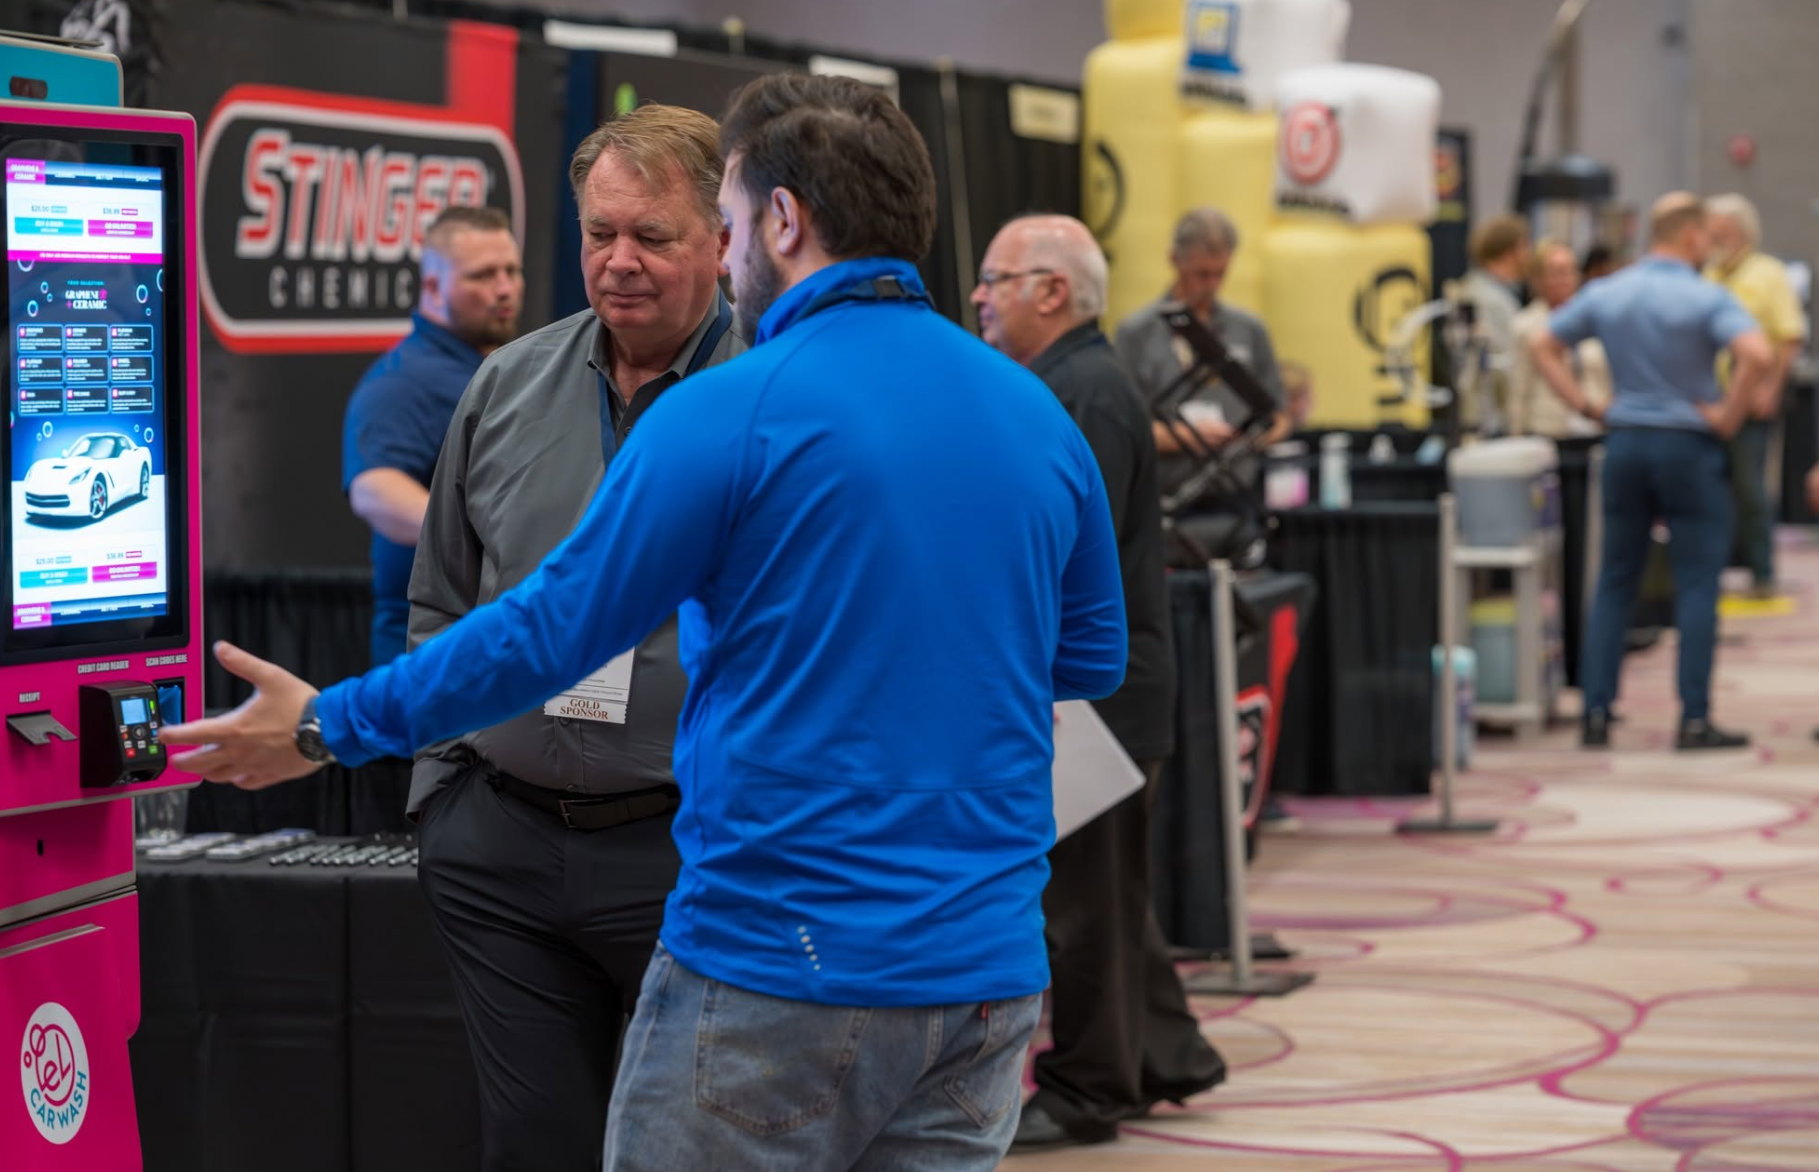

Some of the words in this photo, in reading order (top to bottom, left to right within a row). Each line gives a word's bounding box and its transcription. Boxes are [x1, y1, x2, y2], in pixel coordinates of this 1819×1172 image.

[268, 266, 414, 308] CHEMIC
[73, 300, 107, 310] CERAMIC
[78, 663, 95, 674] CREDIT
[96, 661, 109, 672] CARD
[110, 660, 129, 671] READER
[146, 657, 158, 667] SCAN
[175, 653, 187, 663] HERE
[19, 692, 40, 703] RECEIPT
[570, 698, 600, 710] GOLD
[560, 706, 609, 720] SPONSOR
